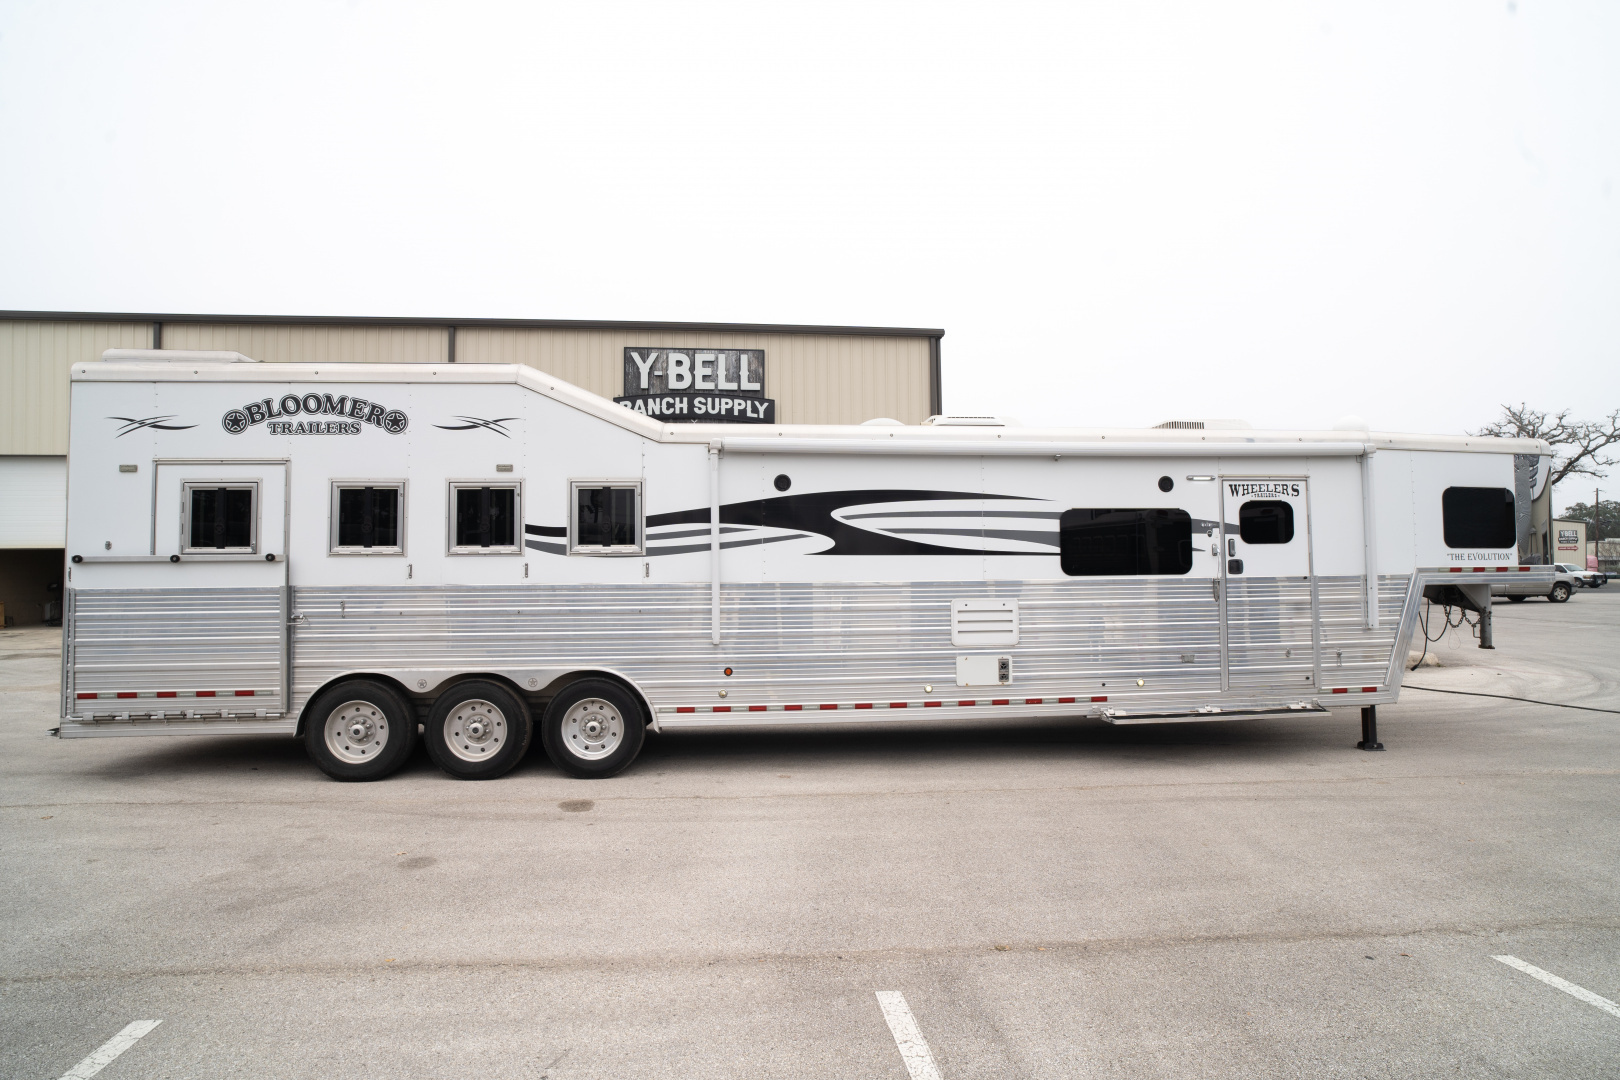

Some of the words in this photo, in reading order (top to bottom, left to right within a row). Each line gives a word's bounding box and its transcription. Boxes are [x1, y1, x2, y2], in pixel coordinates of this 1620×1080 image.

[630, 352, 761, 390] Y-BELL
[243, 393, 387, 427] BLOOMER
[693, 397, 769, 419] SUPPLY
[267, 421, 361, 435] TRAILERS
[1228, 483, 1300, 497] WHEELER'S
